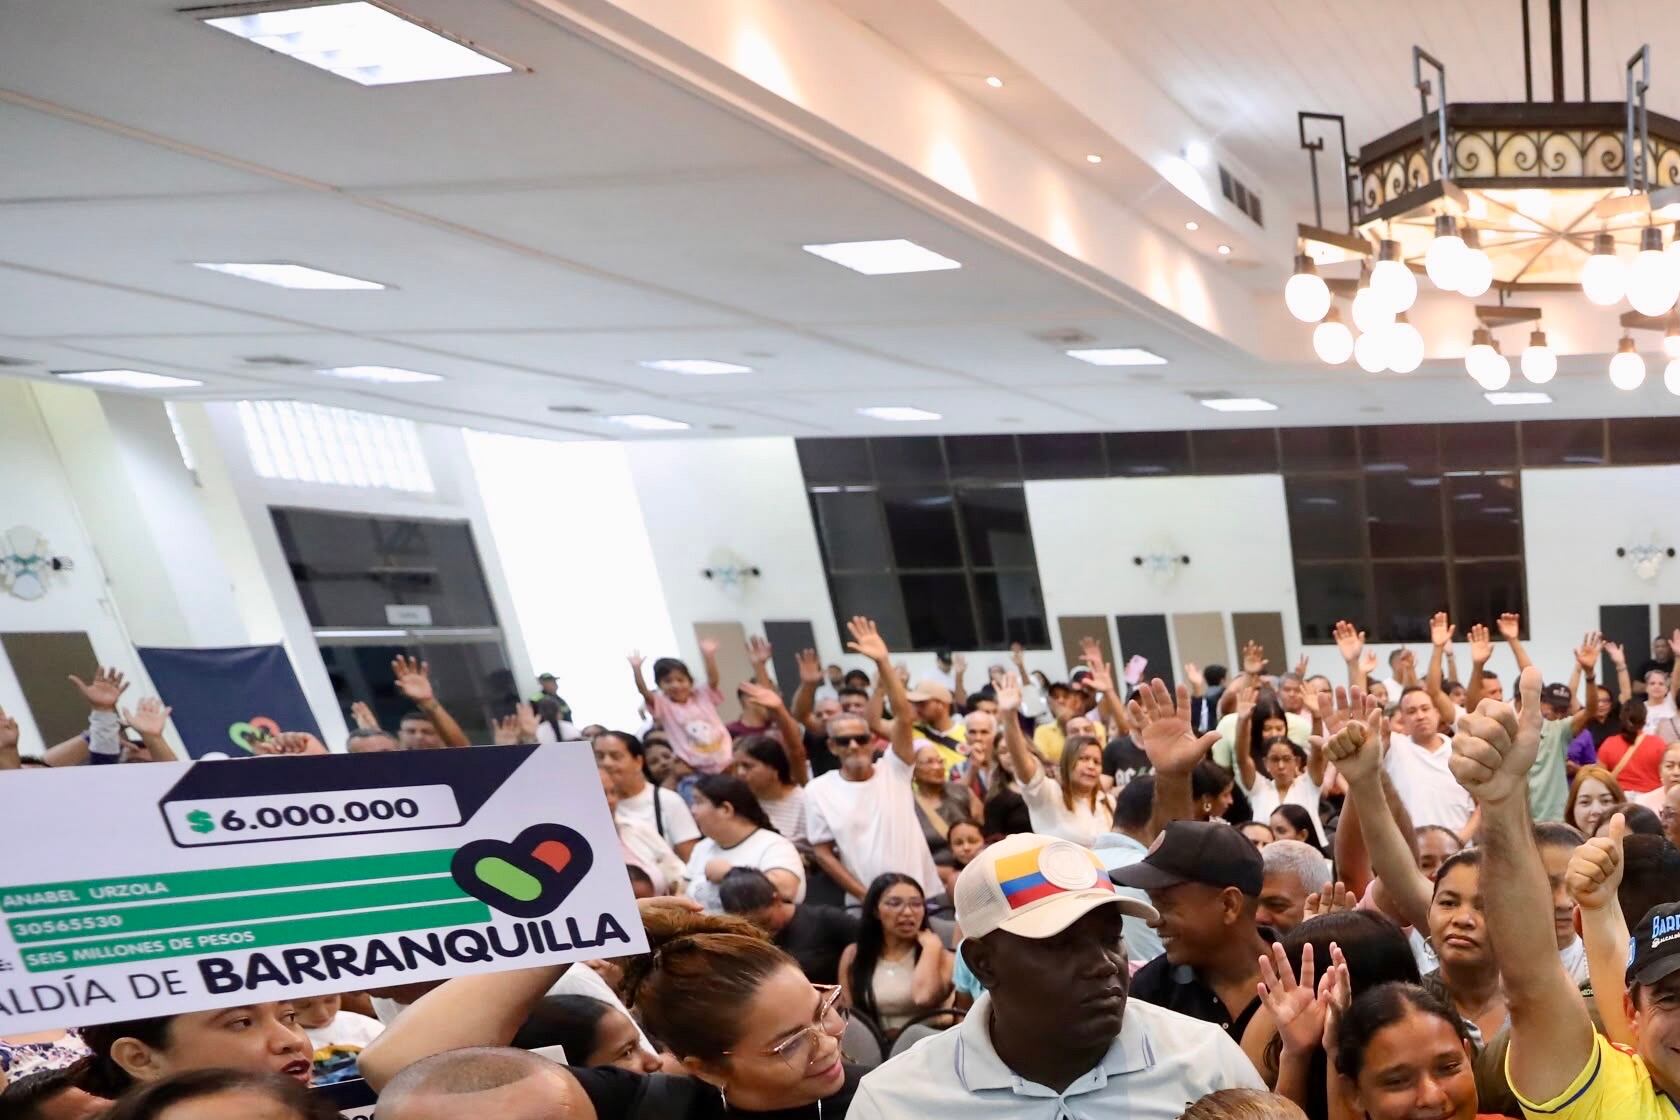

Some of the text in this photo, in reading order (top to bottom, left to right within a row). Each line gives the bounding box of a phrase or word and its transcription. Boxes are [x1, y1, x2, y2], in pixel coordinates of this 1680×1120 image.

[2, 881, 169, 907] ANABEL URZOLA
[15, 914, 123, 937] 30565530
[0, 912, 630, 1016] LDÍA DE BARRANQUILLA
[25, 951, 68, 967] SEIS
[73, 940, 166, 961] MILLONES
[169, 937, 193, 950] DE
[200, 930, 256, 947] PESOS
